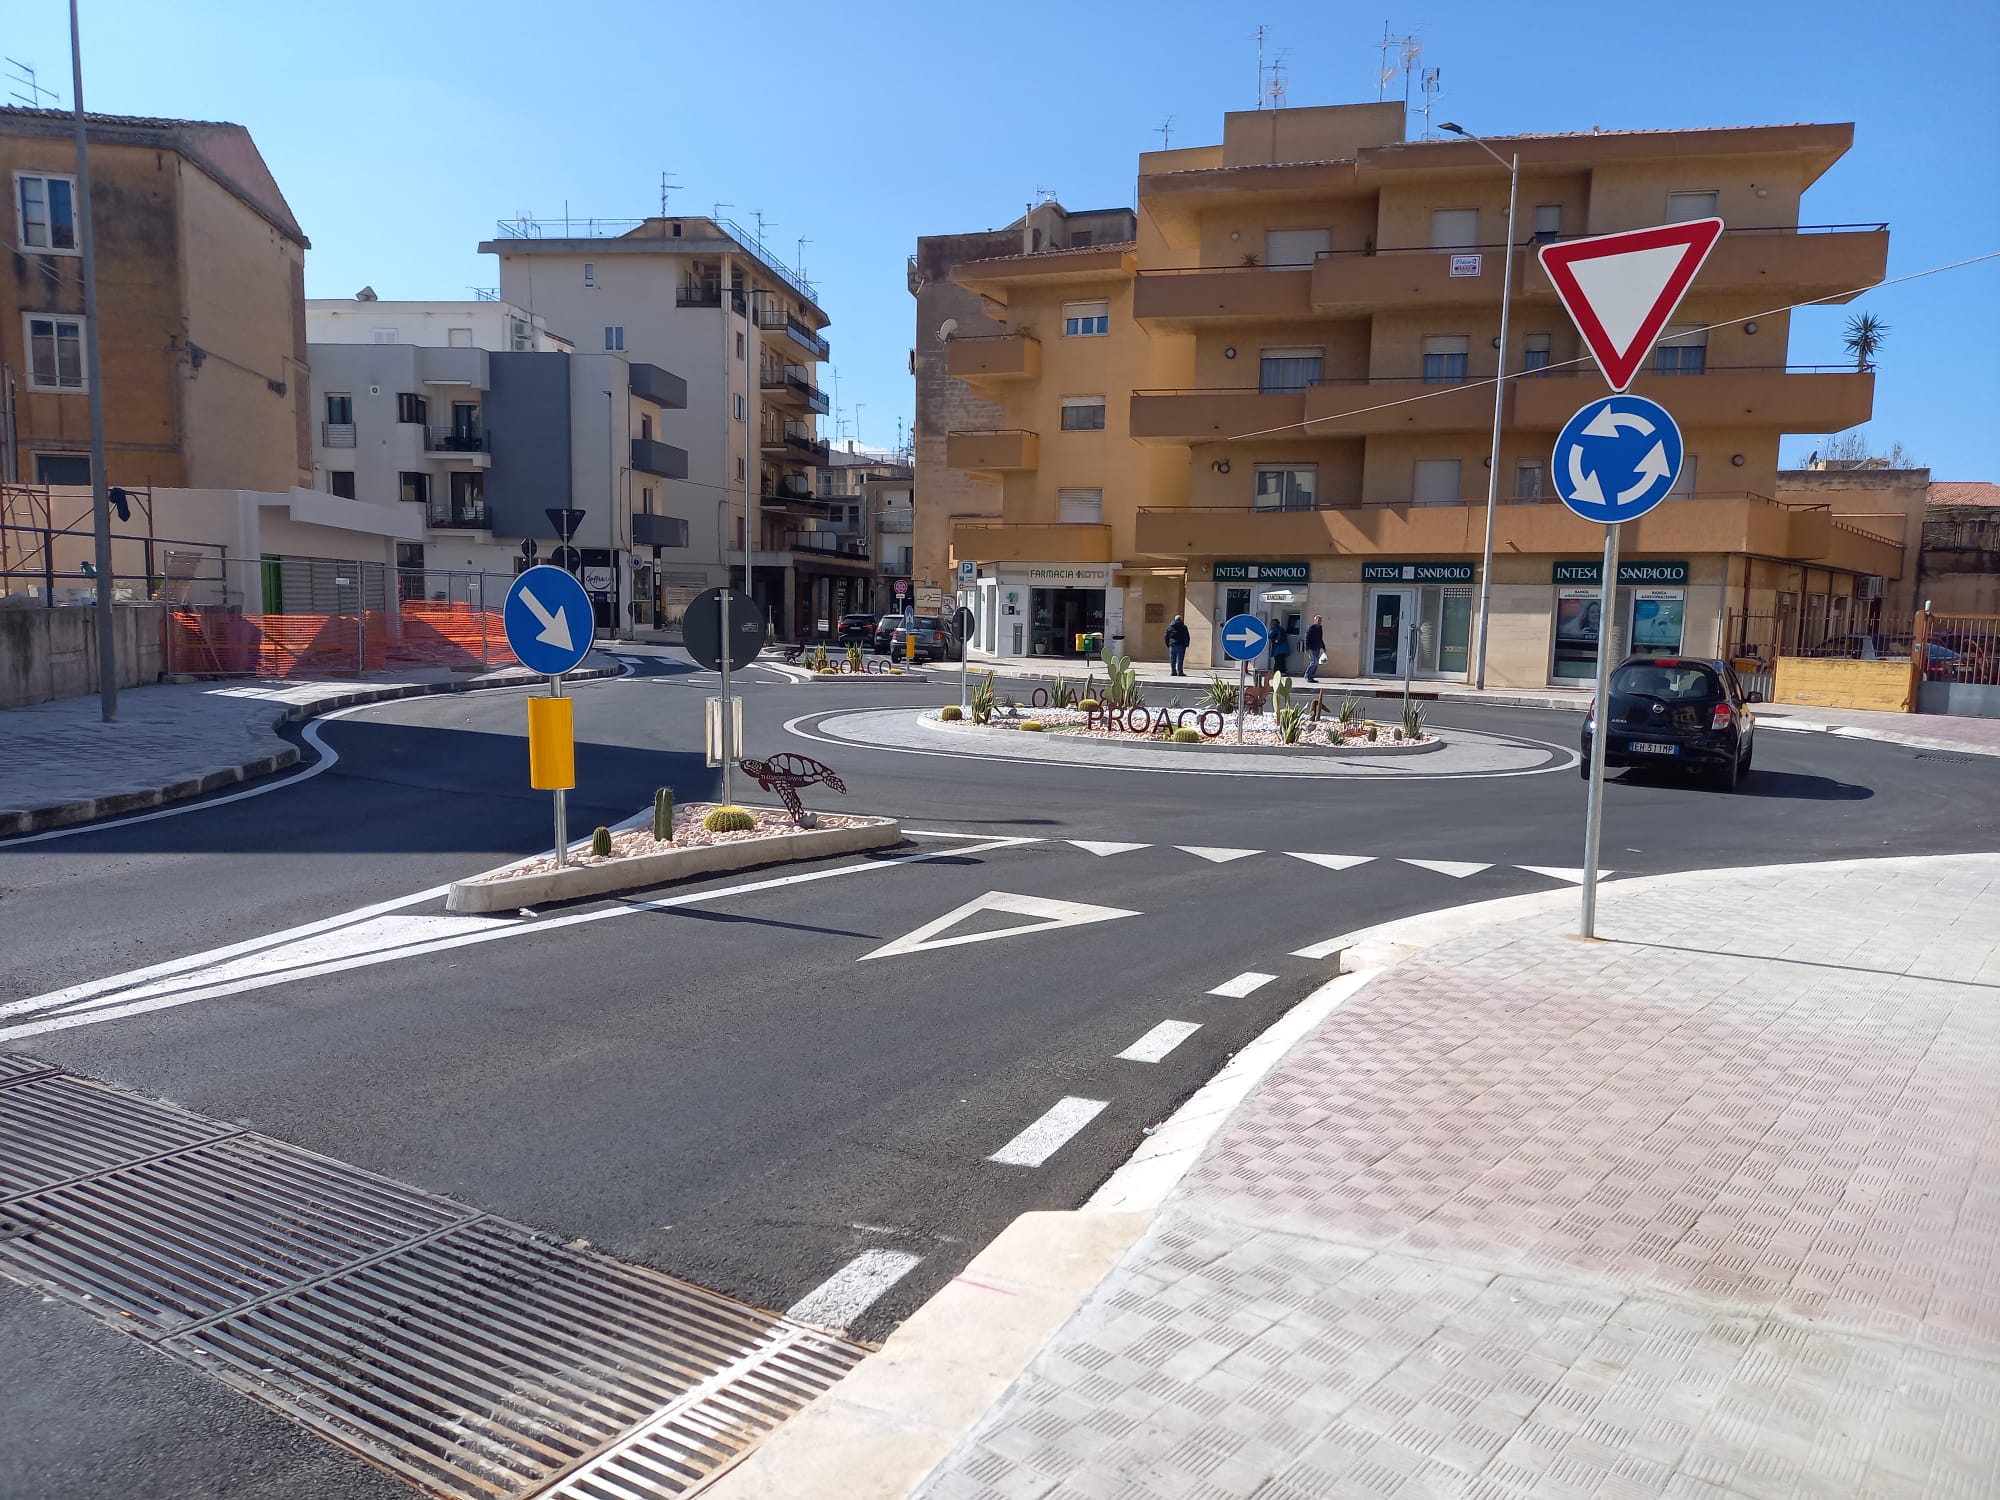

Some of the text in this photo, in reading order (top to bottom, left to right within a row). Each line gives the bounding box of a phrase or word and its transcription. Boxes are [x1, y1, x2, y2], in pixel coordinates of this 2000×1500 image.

[1030, 569, 1074, 579] FARMACIA
[1216, 567, 1306, 577] INTESA SANPAOLO
[1364, 567, 1471, 579] INTESA SANPAOLO
[1556, 567, 1684, 580] INTESA SANPAOLO
[1086, 704, 1225, 738] PROACO
